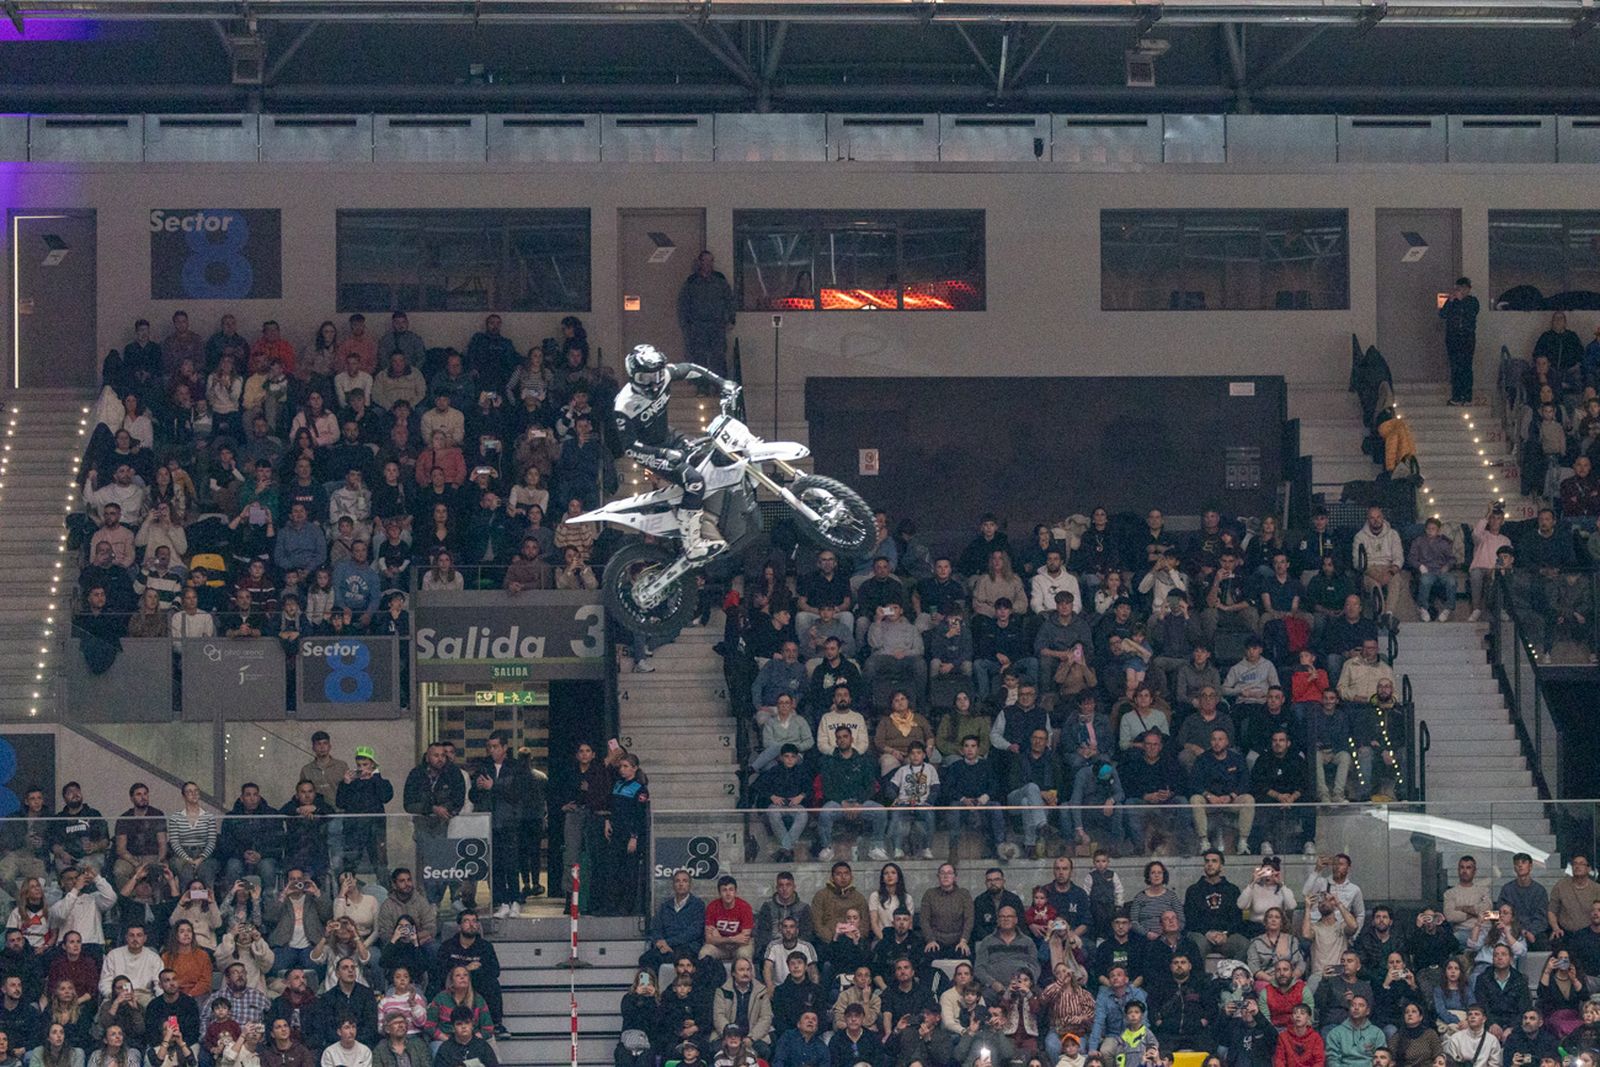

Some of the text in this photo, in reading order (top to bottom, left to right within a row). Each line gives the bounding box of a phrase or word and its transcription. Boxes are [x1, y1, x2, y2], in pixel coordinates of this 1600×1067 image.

[150, 210, 233, 232] Sector
[181, 208, 253, 299] 8
[417, 605, 604, 659] Salida 3
[303, 642, 359, 656] Sector
[325, 640, 373, 703] 8
[494, 667, 528, 676] SALIDA
[423, 866, 471, 879] Sector
[455, 837, 488, 881] 8
[686, 835, 720, 880] 8
[716, 920, 739, 932] 93
